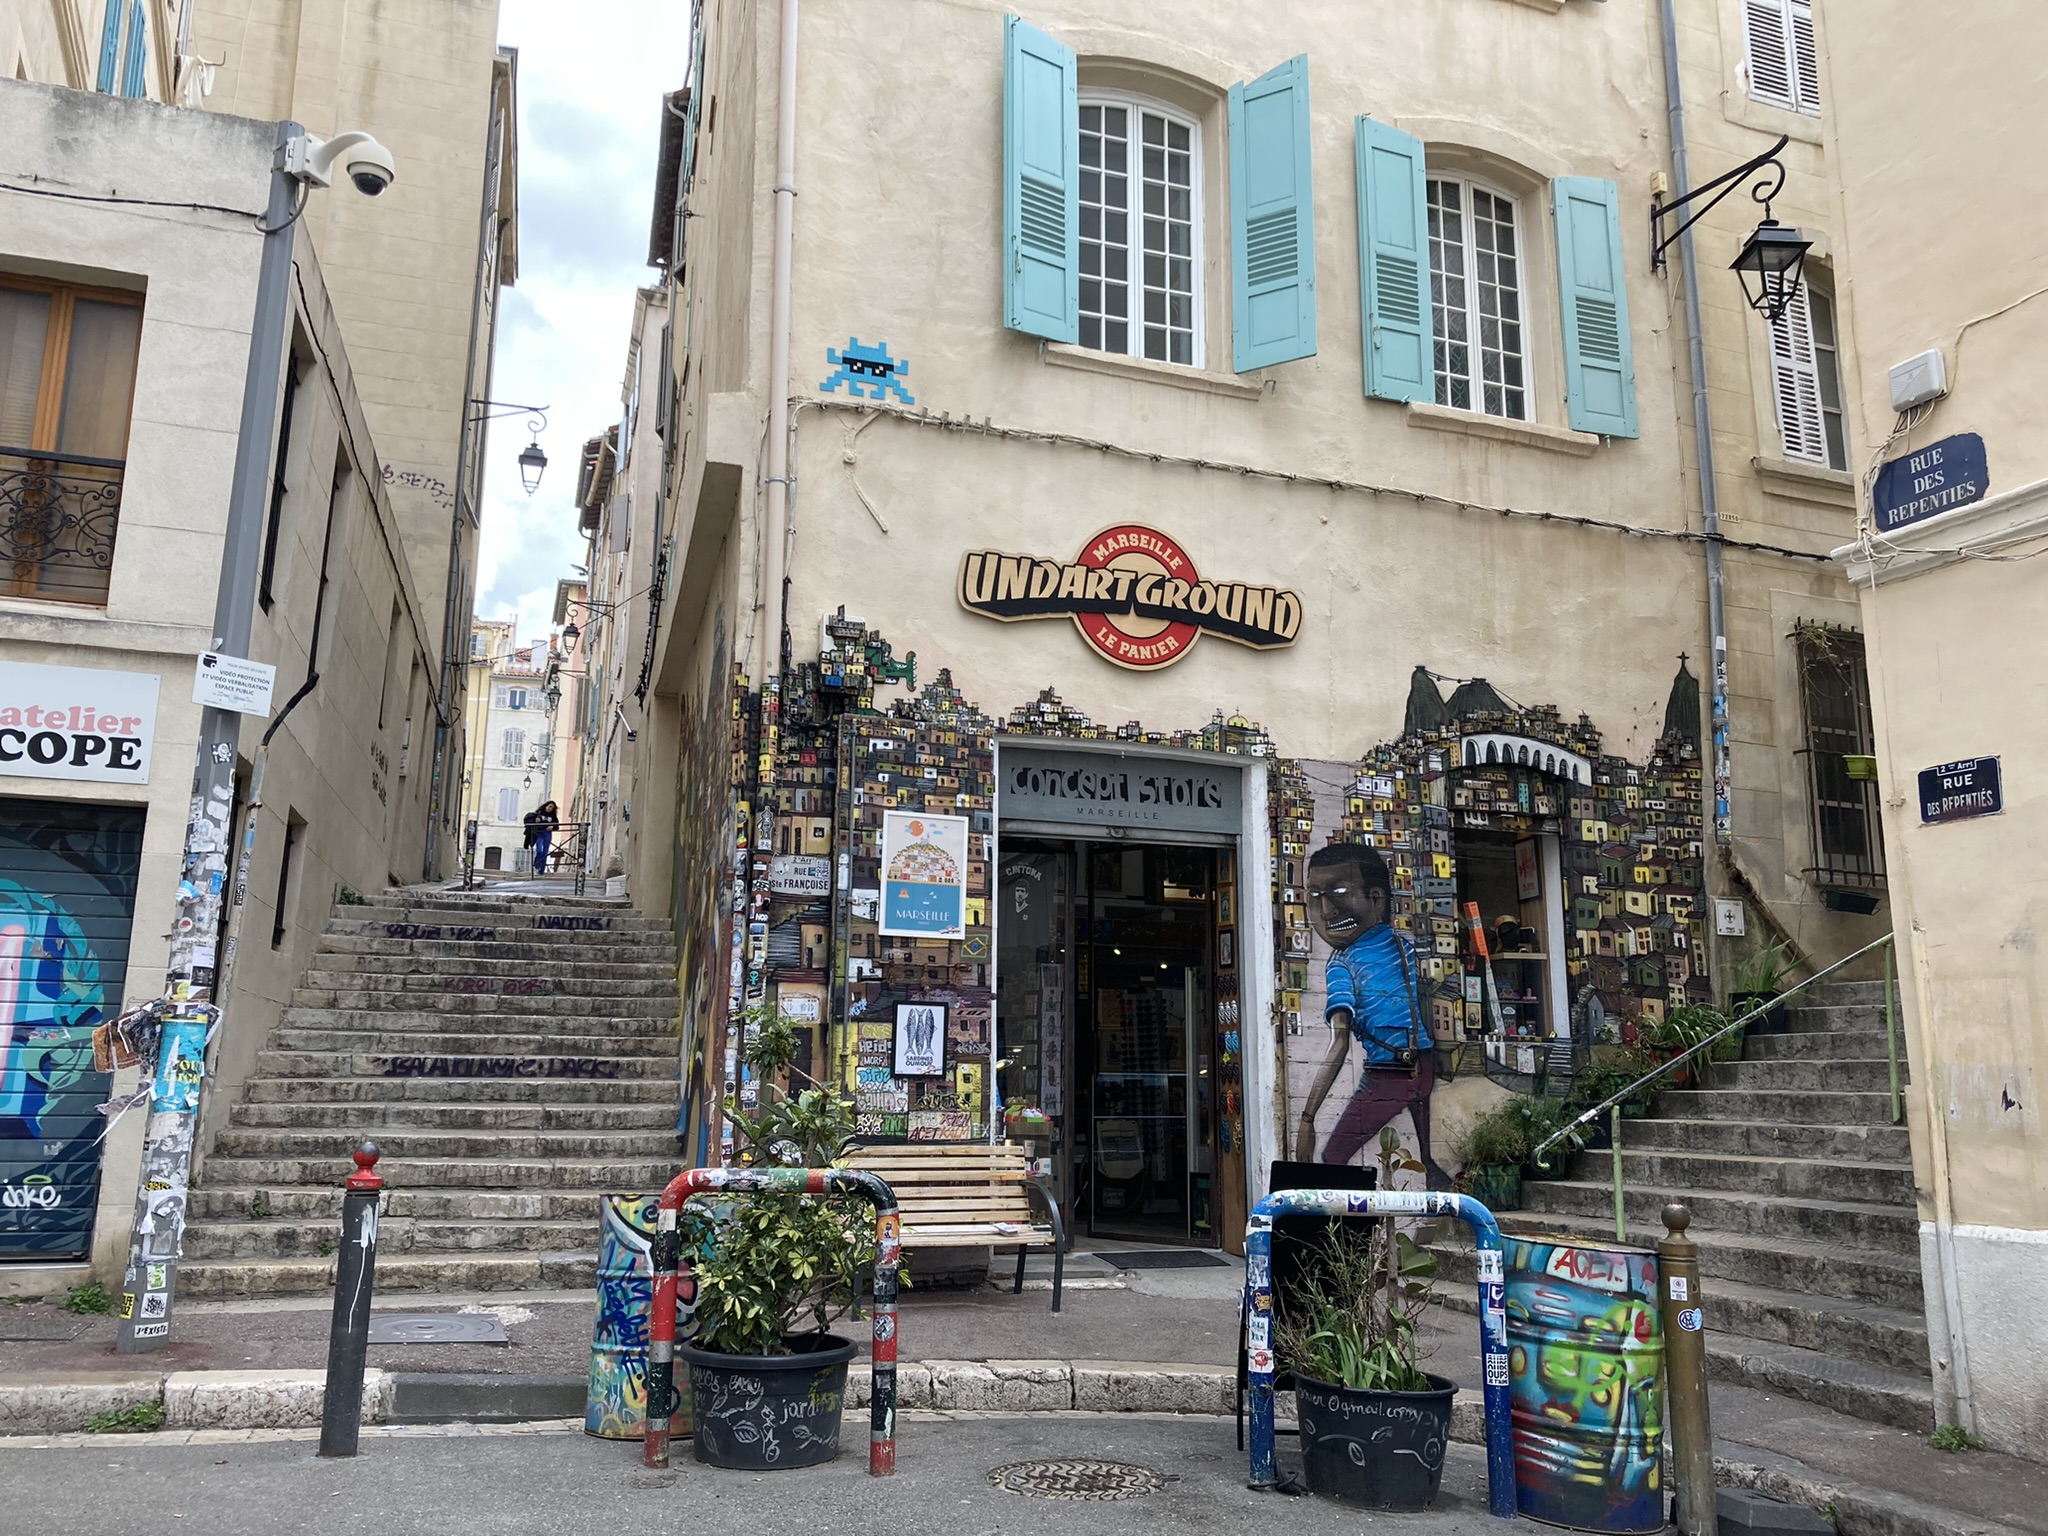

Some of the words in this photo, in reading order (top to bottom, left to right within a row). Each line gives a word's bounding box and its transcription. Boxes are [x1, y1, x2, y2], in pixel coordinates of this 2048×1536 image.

[1909, 447, 1944, 474] RUE
[1913, 469, 1945, 494] DES
[1887, 480, 1976, 525] REPENTIES
[1092, 533, 1183, 571] MARSEILLE
[963, 551, 1303, 641] UNDARTGROUND
[1096, 625, 1117, 650] LE
[1119, 635, 1181, 661] PANIER
[210, 675, 227, 683] VIDÉO
[228, 677, 268, 692] VERBALISATION
[219, 670, 237, 679] VIDÉO
[237, 672, 270, 685] PROTECTION
[215, 683, 235, 693] ESPACE
[235, 687, 254, 696] PUBLIC
[0, 704, 142, 735] atelier
[1943, 773, 1974, 790] RUE
[1076, 807, 1159, 820] MARSEILLE
[1926, 801, 1940, 817] DES
[794, 867, 807, 876] RUE
[1005, 864, 1042, 881] CANTONA
[771, 879, 783, 888] Ste
[784, 879, 829, 891] FRANÇOISE
[896, 908, 950, 922] MARSEILLE
[136, 1324, 167, 1336] J'EXISTE
[1488, 1370, 1508, 1379] OUPS
